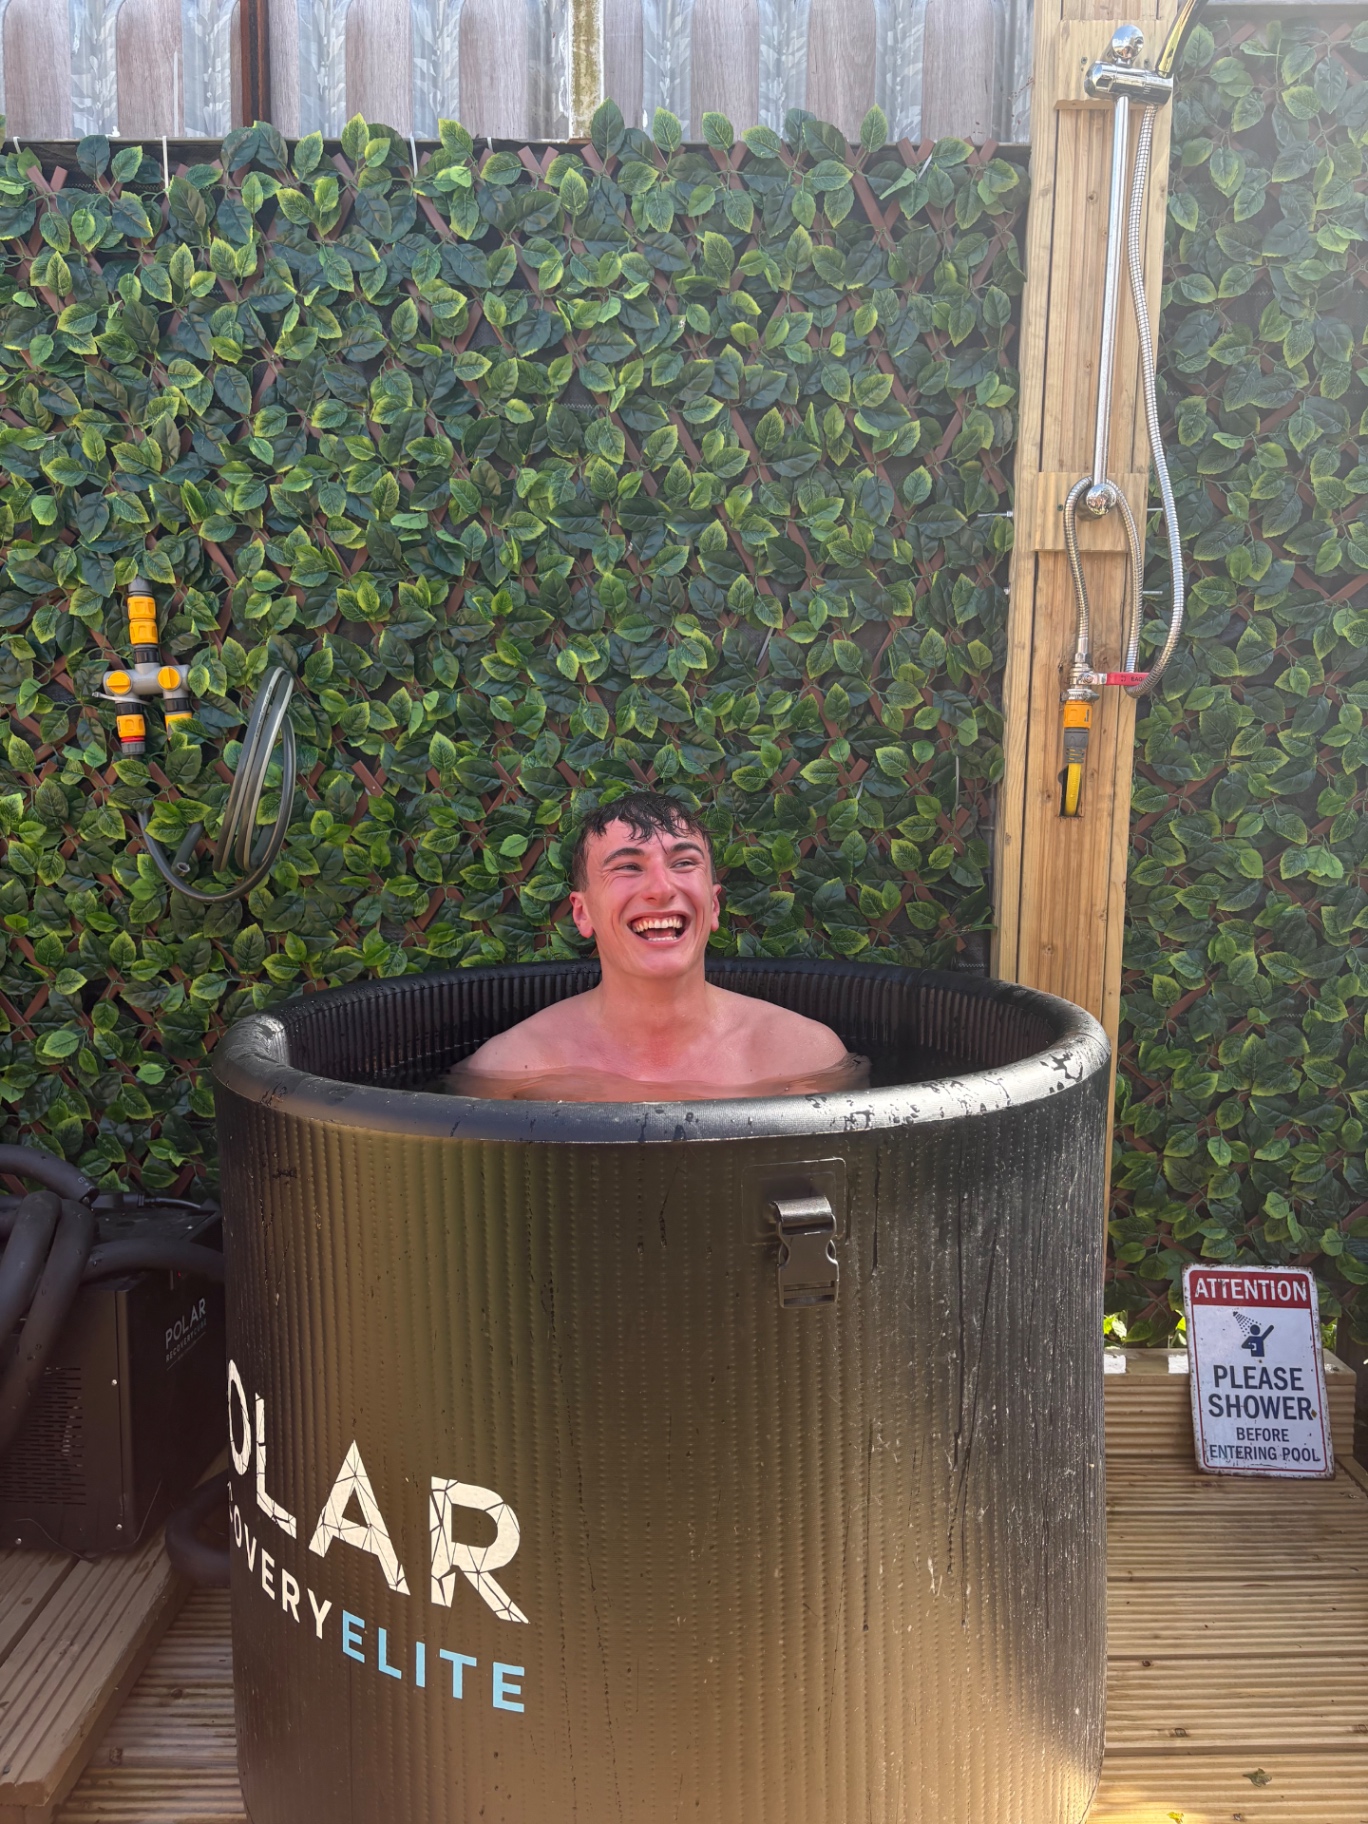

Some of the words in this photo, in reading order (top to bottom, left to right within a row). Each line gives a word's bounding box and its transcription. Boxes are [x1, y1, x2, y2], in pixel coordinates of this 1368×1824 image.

[1194, 1277, 1307, 1302] ATTENTION
[165, 1298, 206, 1350] POLAR
[1213, 1364, 1305, 1392] PLEASE
[1208, 1392, 1314, 1421] SHOWER
[1236, 1427, 1290, 1443] BEFORE
[1209, 1444, 1278, 1461] ENTERING
[1282, 1446, 1321, 1463] POOL
